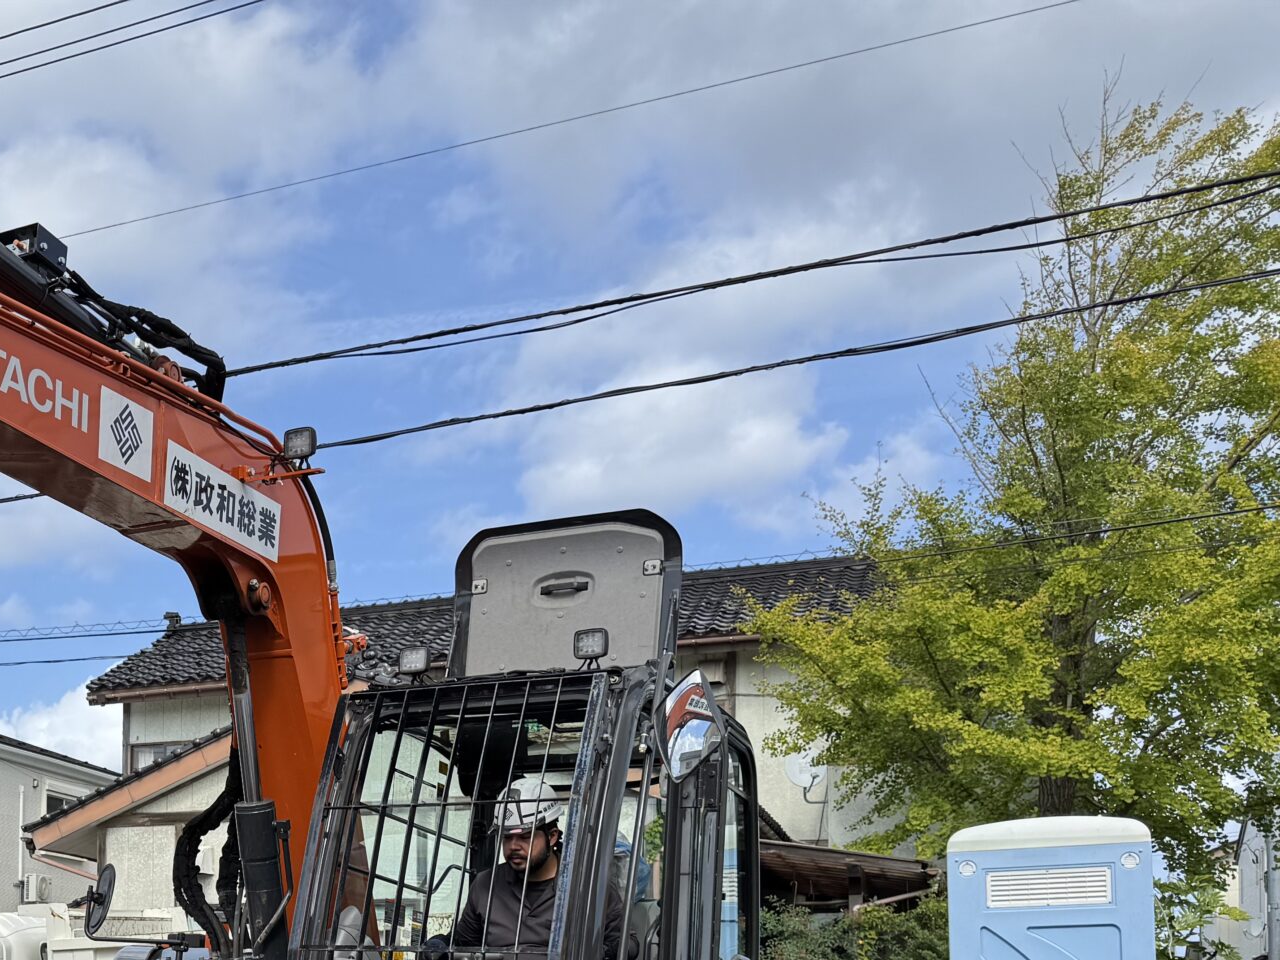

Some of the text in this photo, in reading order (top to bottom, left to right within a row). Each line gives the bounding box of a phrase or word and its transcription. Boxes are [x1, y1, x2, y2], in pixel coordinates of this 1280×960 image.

[170, 456, 276, 549] (株)政和総業
